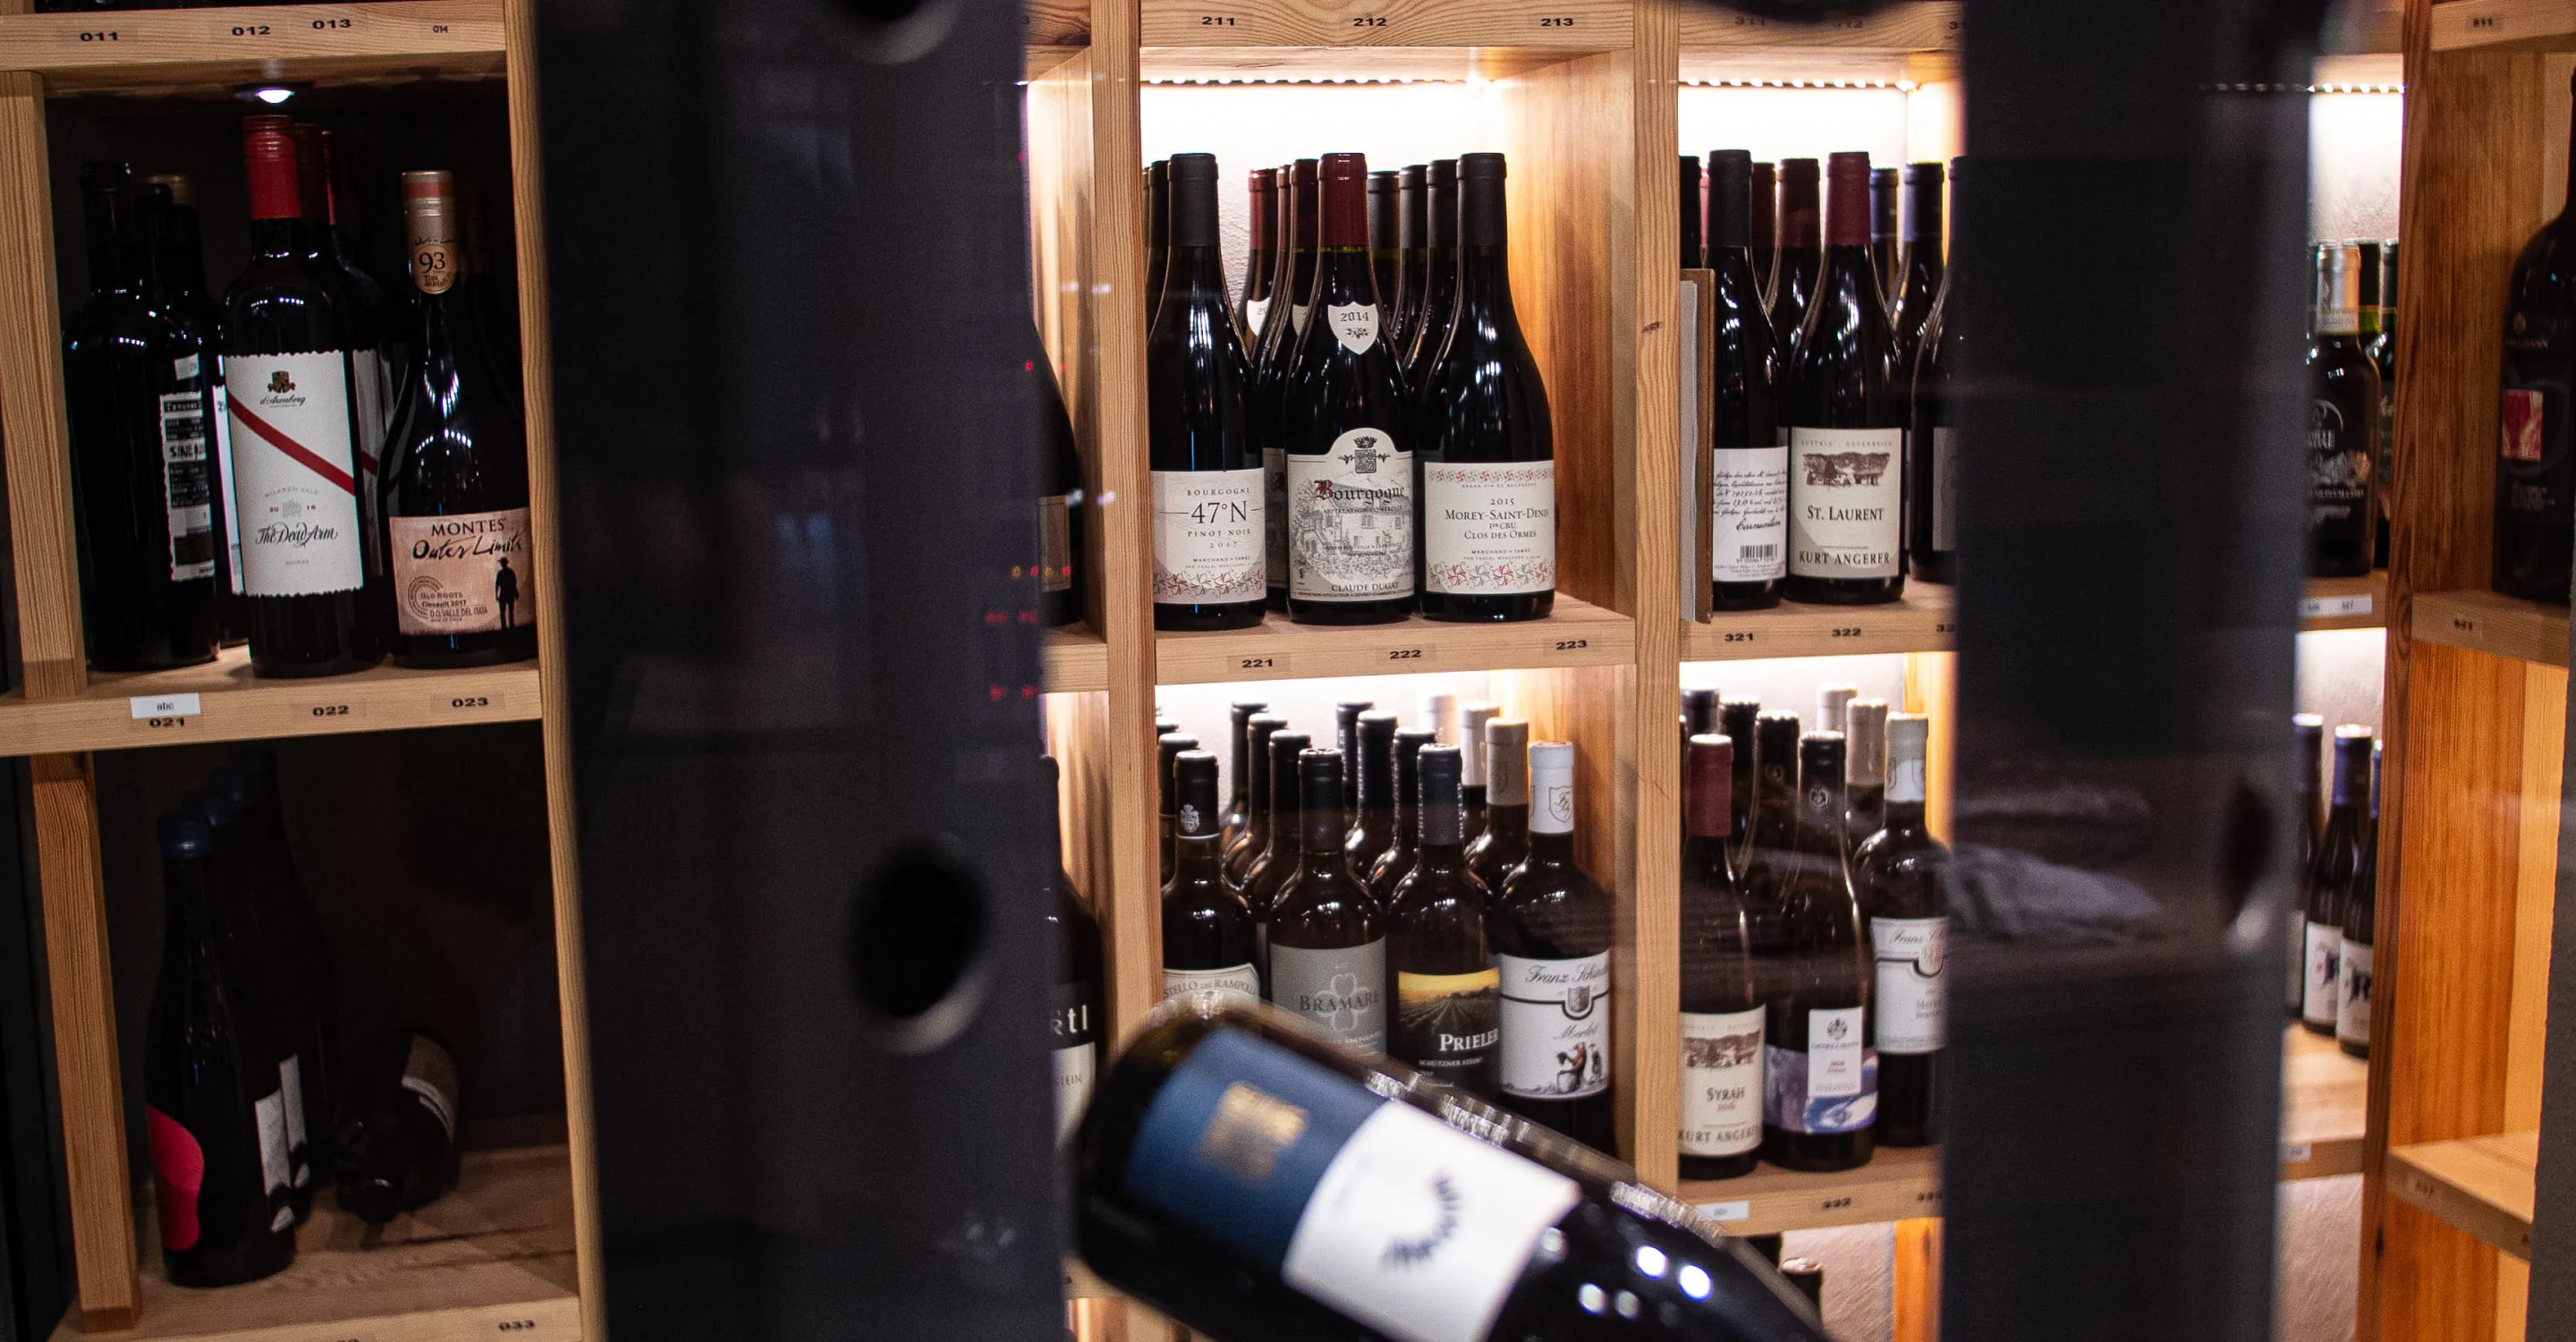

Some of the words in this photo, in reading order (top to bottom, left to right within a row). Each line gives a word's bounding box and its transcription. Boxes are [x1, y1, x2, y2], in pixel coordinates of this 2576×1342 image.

[312, 19, 352, 30] 013
[1201, 16, 1236, 26] 211
[1352, 17, 1387, 27] 212
[1540, 18, 1574, 27] 213
[232, 26, 271, 37] 012
[432, 25, 448, 33] 014
[80, 32, 119, 42] 011
[419, 252, 445, 275] 93
[1341, 312, 1369, 322] 2014
[1314, 480, 1404, 505] Bourgogne
[1490, 497, 1515, 505] 2015
[1807, 505, 1825, 520] ST.
[1828, 506, 1885, 521] LAURENT
[431, 519, 504, 537] MONTES
[1499, 522, 1517, 530] CRU
[1187, 530, 1223, 538] PINOT
[1228, 528, 1251, 537] NOIR
[1464, 530, 1488, 539] CLOS
[1491, 531, 1507, 539] DES
[1509, 529, 1537, 539] ORMES
[412, 535, 476, 560] Outer
[1799, 550, 1829, 565] KURT
[1834, 551, 1890, 565] ANGERER
[1331, 583, 1368, 592] CLAUDE
[1371, 581, 1400, 590] DUGAT
[1724, 633, 1754, 642] 321
[1831, 628, 1861, 638] 322
[1555, 640, 1588, 650] 223
[1389, 649, 1422, 659] 222
[1241, 658, 1274, 668] 221
[451, 697, 488, 709] 023
[312, 705, 349, 717] 022
[148, 717, 185, 728] 021
[1525, 964, 1572, 983] Franz
[1438, 1027, 1499, 1051] PRIELER
[1706, 1086, 1746, 1101] SYRAH
[498, 1319, 535, 1331] 033
